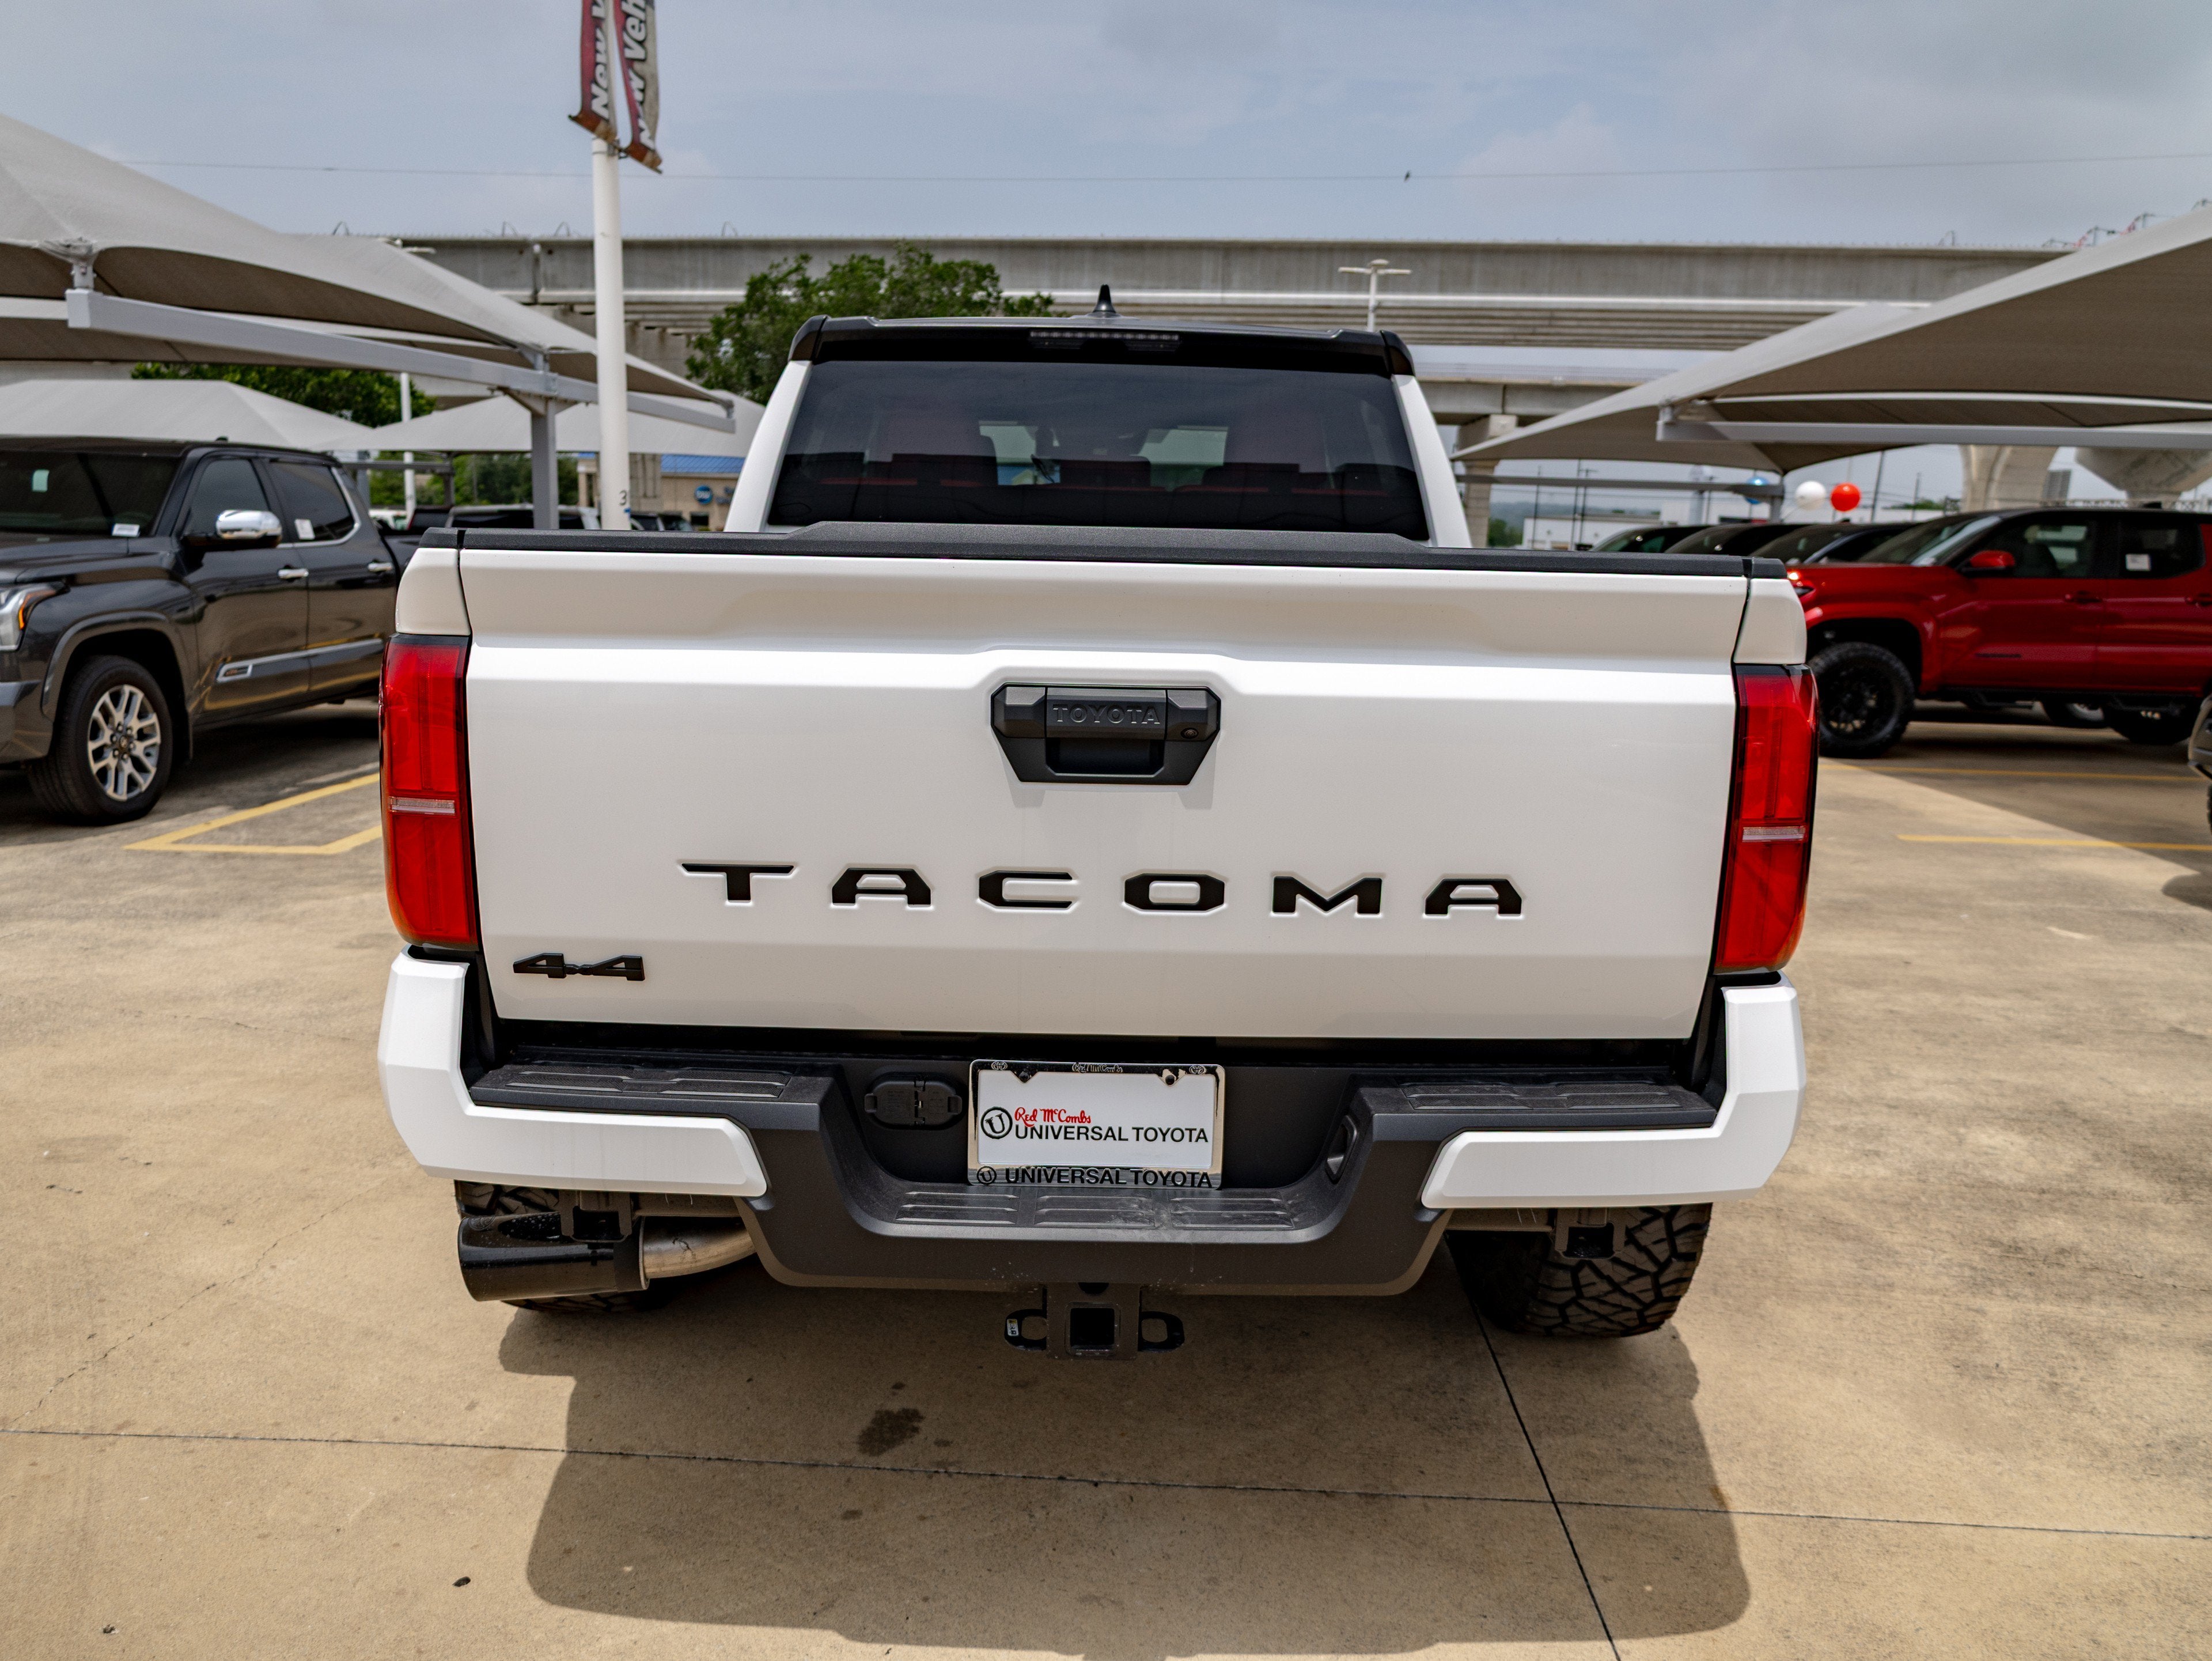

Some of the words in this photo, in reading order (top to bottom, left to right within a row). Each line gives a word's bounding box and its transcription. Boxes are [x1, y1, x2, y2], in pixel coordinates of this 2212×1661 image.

[590, 27, 609, 120] New
[628, 67, 656, 152] Nw
[619, 490, 627, 506] 3
[1052, 703, 1160, 724] TOYOTA
[681, 863, 1522, 915] TACOMA
[1014, 1107, 1037, 1127] Red
[1040, 1108, 1092, 1123] McCombs
[1015, 1123, 1128, 1141] UNIVERSAL
[1131, 1126, 1209, 1142] TOYOTA
[1005, 1166, 1127, 1185] UNIVERSAL
[1130, 1168, 1212, 1187] TOYOTA
